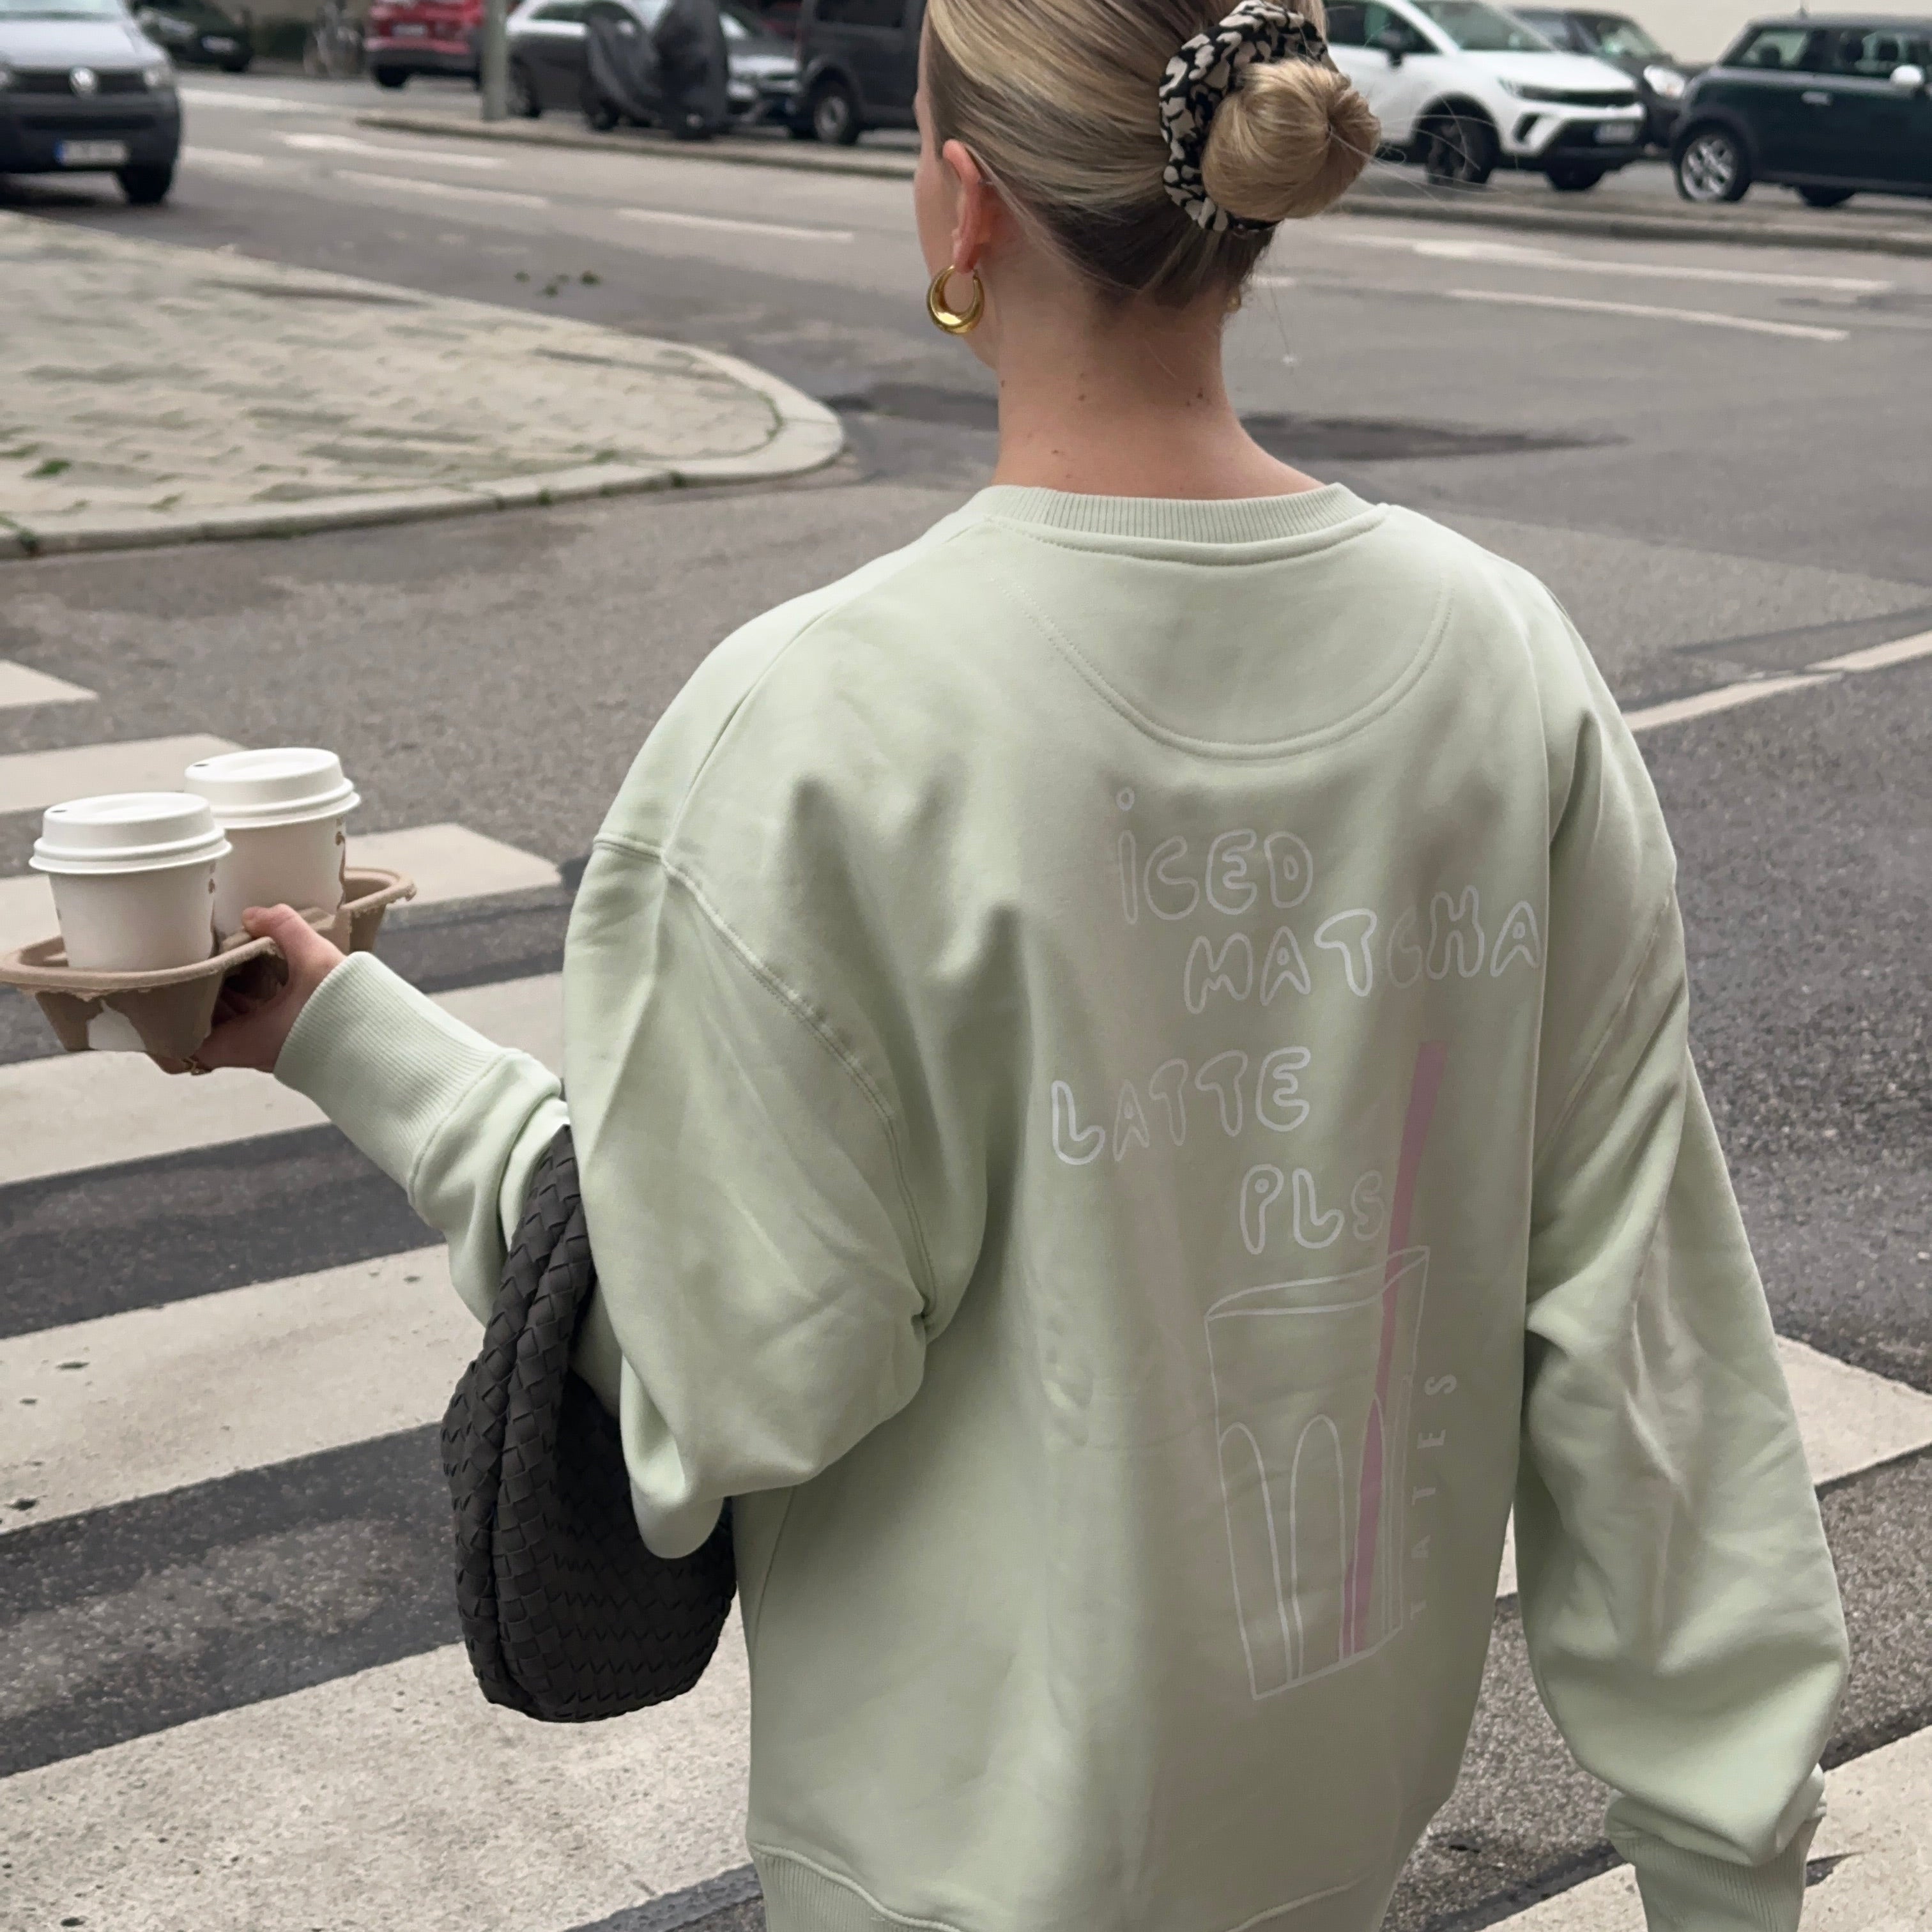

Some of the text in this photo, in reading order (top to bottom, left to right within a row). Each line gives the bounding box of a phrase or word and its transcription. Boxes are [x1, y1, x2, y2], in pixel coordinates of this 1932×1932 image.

[1183, 885, 1542, 1014] MATCHA
[1051, 1046, 1310, 1165] LATTE
[1239, 1164, 1386, 1255] PLS
